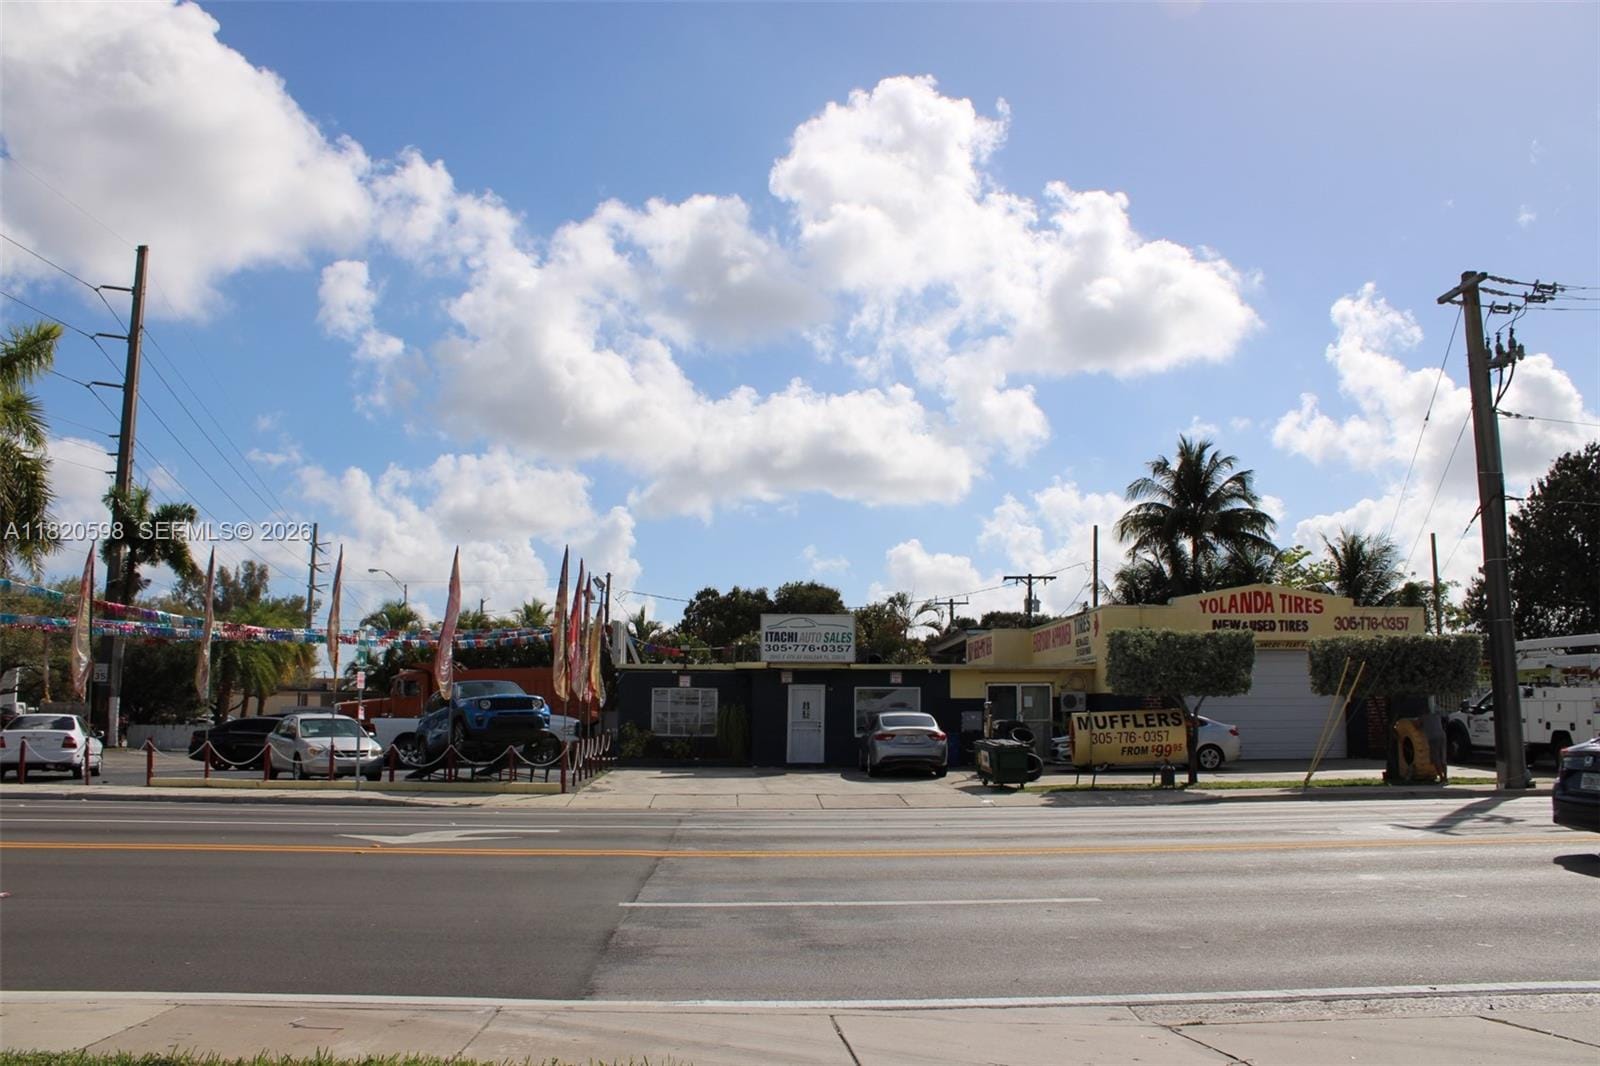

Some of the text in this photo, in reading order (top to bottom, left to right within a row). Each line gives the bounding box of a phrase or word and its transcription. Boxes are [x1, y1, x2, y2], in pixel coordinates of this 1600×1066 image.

[1199, 590, 1325, 614] YOLANDA TIRES
[1212, 619, 1240, 630] NEW
[1249, 619, 1277, 632] USED
[1278, 619, 1310, 632] TIRES
[1333, 616, 1410, 631] 305-776-0357
[765, 631, 853, 644] ITACHI AUTO SALES
[1077, 711, 1183, 731] MUFFLERS
[1091, 730, 1170, 745] 305-776-0357
[1121, 746, 1149, 757] FROM
